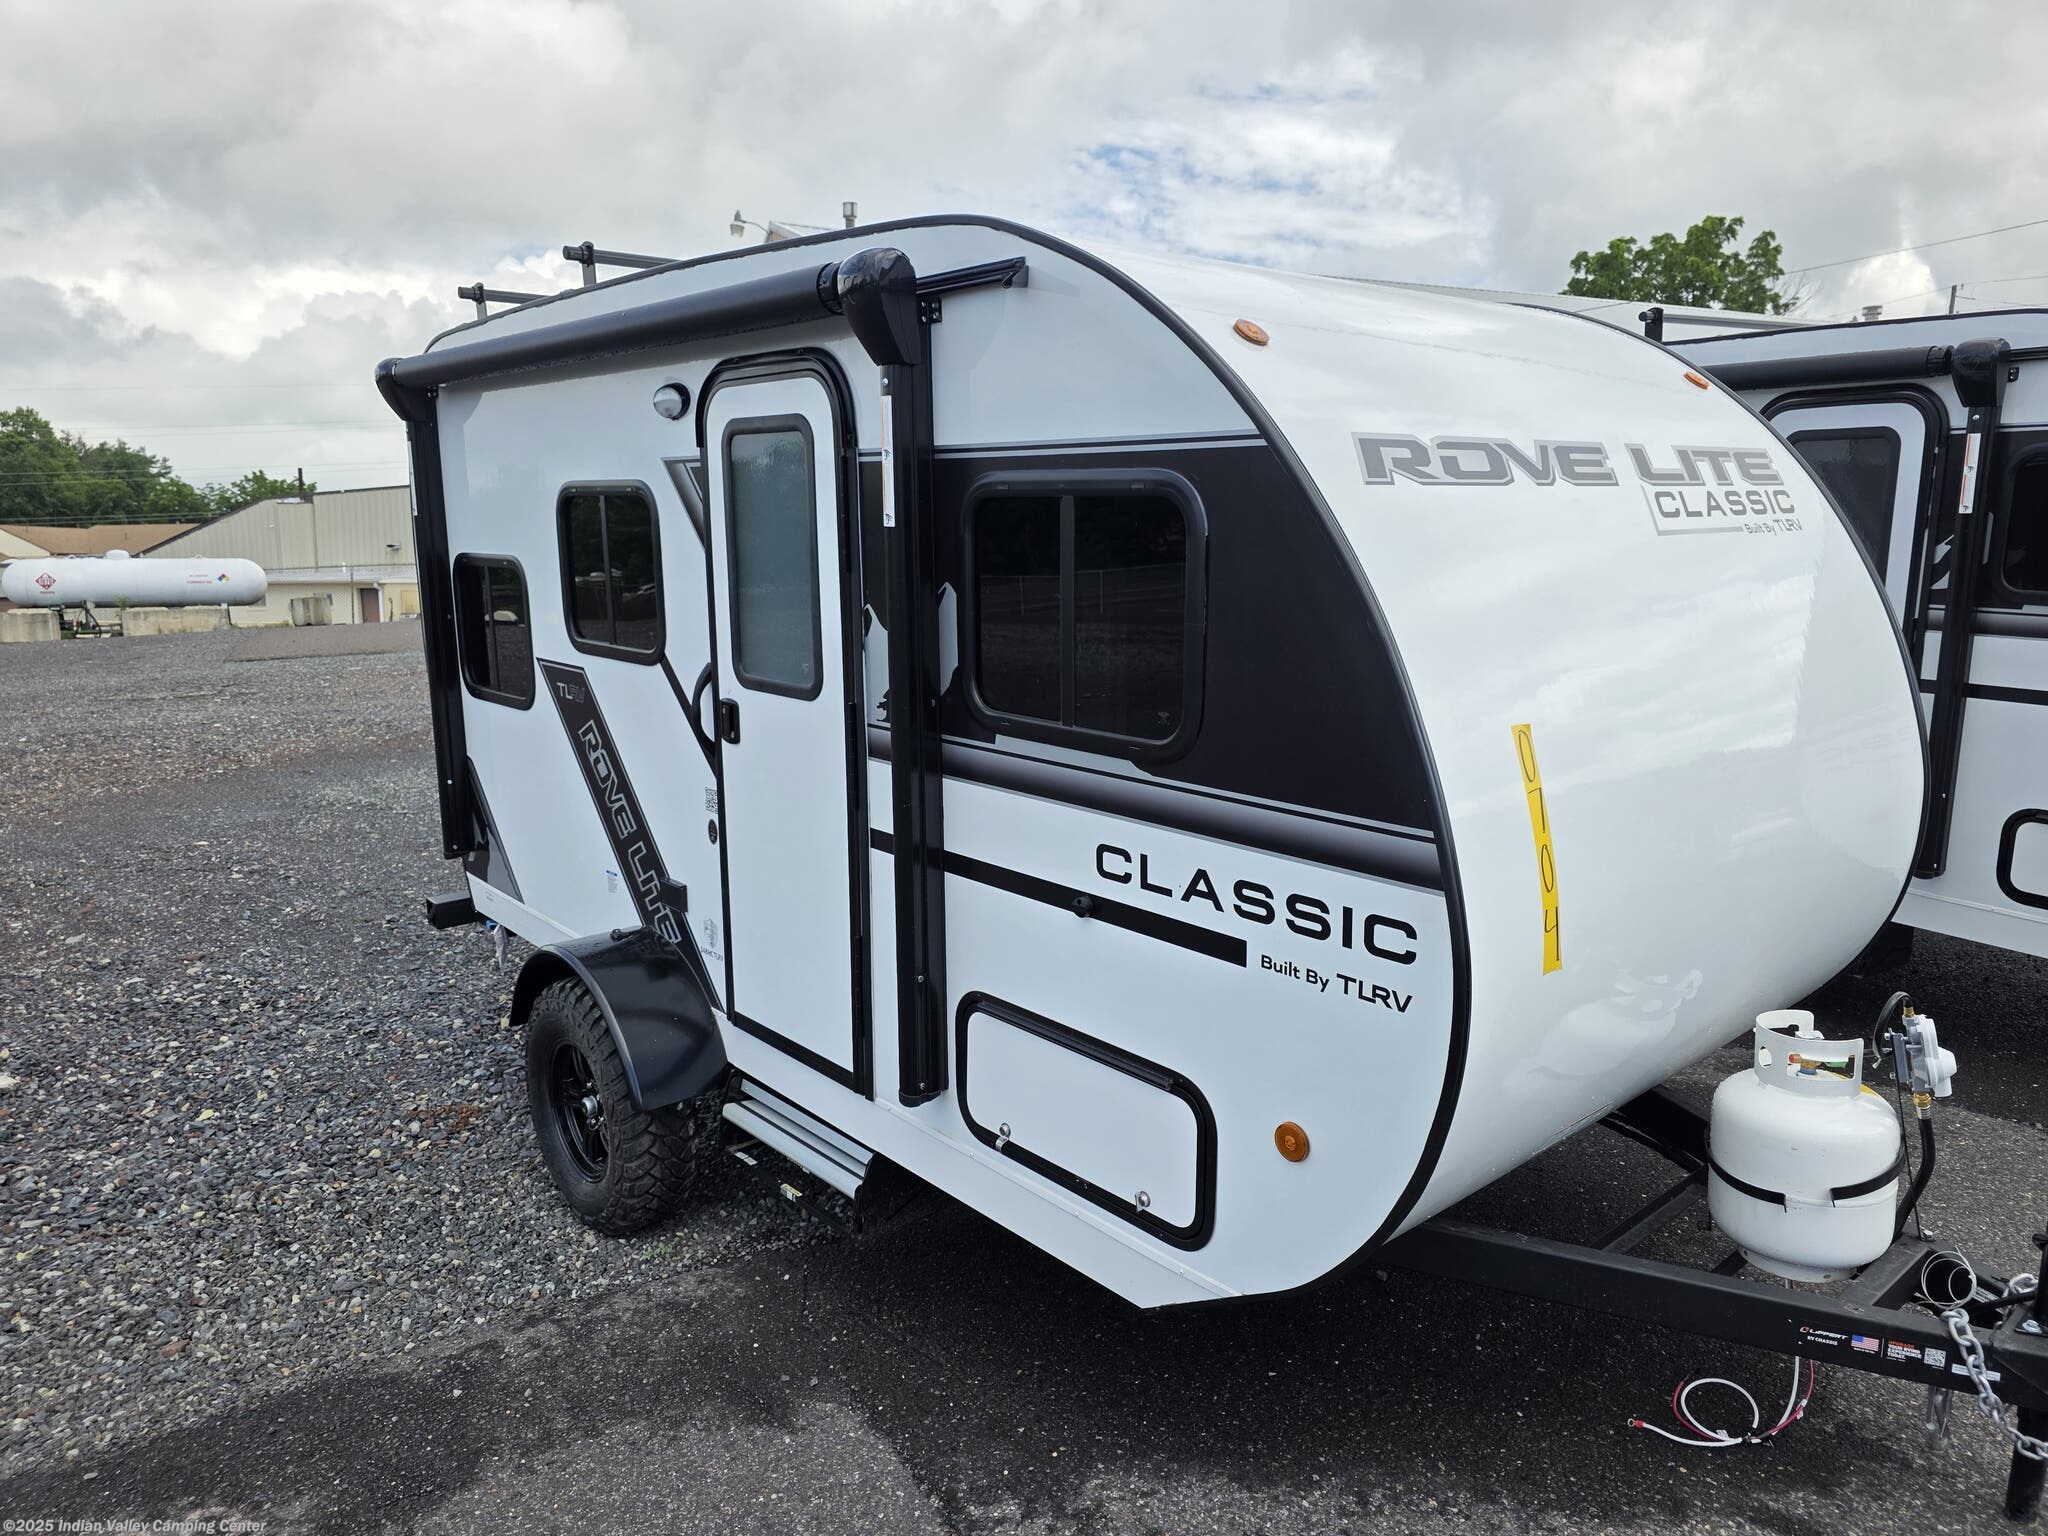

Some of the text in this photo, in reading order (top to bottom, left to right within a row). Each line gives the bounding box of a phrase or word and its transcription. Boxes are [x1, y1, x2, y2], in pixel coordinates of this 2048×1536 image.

[1351, 432, 1785, 487] ROVE LITE
[1653, 489, 1796, 518] CLASSIC
[1744, 518, 1802, 536] Built By TLRV
[578, 719, 637, 839] ROVE
[1095, 843, 1418, 965] CLASSIC
[1261, 954, 1413, 1013] Built By TLRV
[1815, 1337, 1838, 1346] CHASSIS
